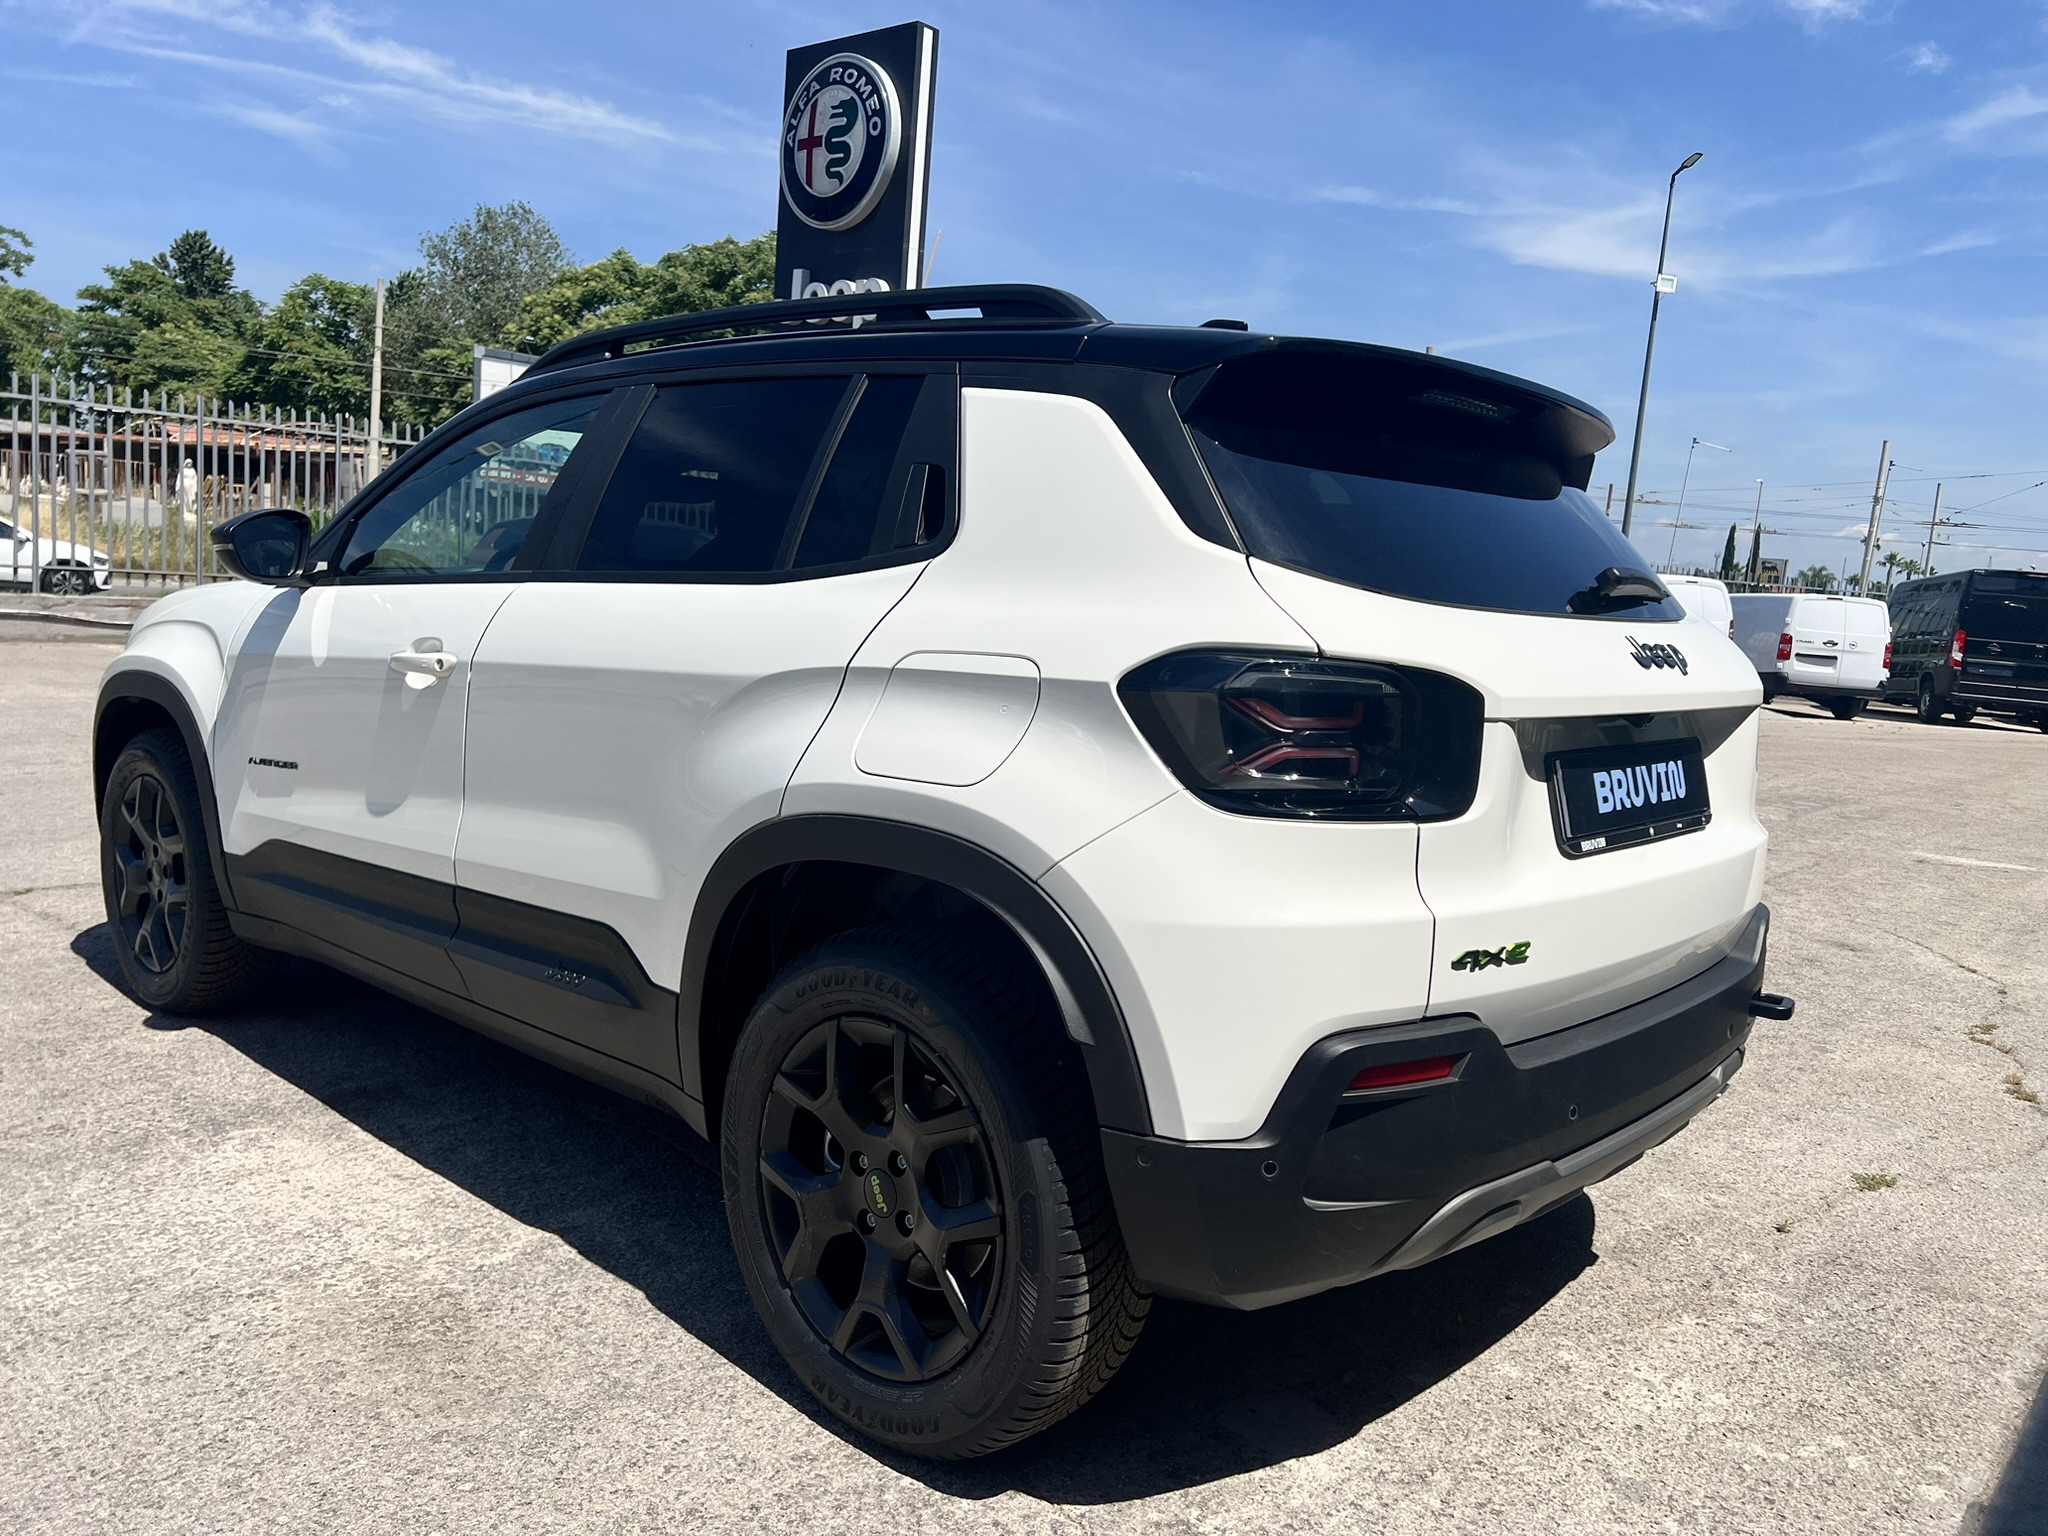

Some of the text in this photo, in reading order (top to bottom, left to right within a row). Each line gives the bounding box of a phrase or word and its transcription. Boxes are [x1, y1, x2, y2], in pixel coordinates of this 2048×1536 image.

[785, 66, 882, 148] ALFA ROMEO
[1624, 635, 1689, 677] Jeep
[1592, 759, 1688, 815] BRUVIN
[1580, 836, 1607, 852] BRUVIN
[869, 1174, 888, 1214] Jeep
